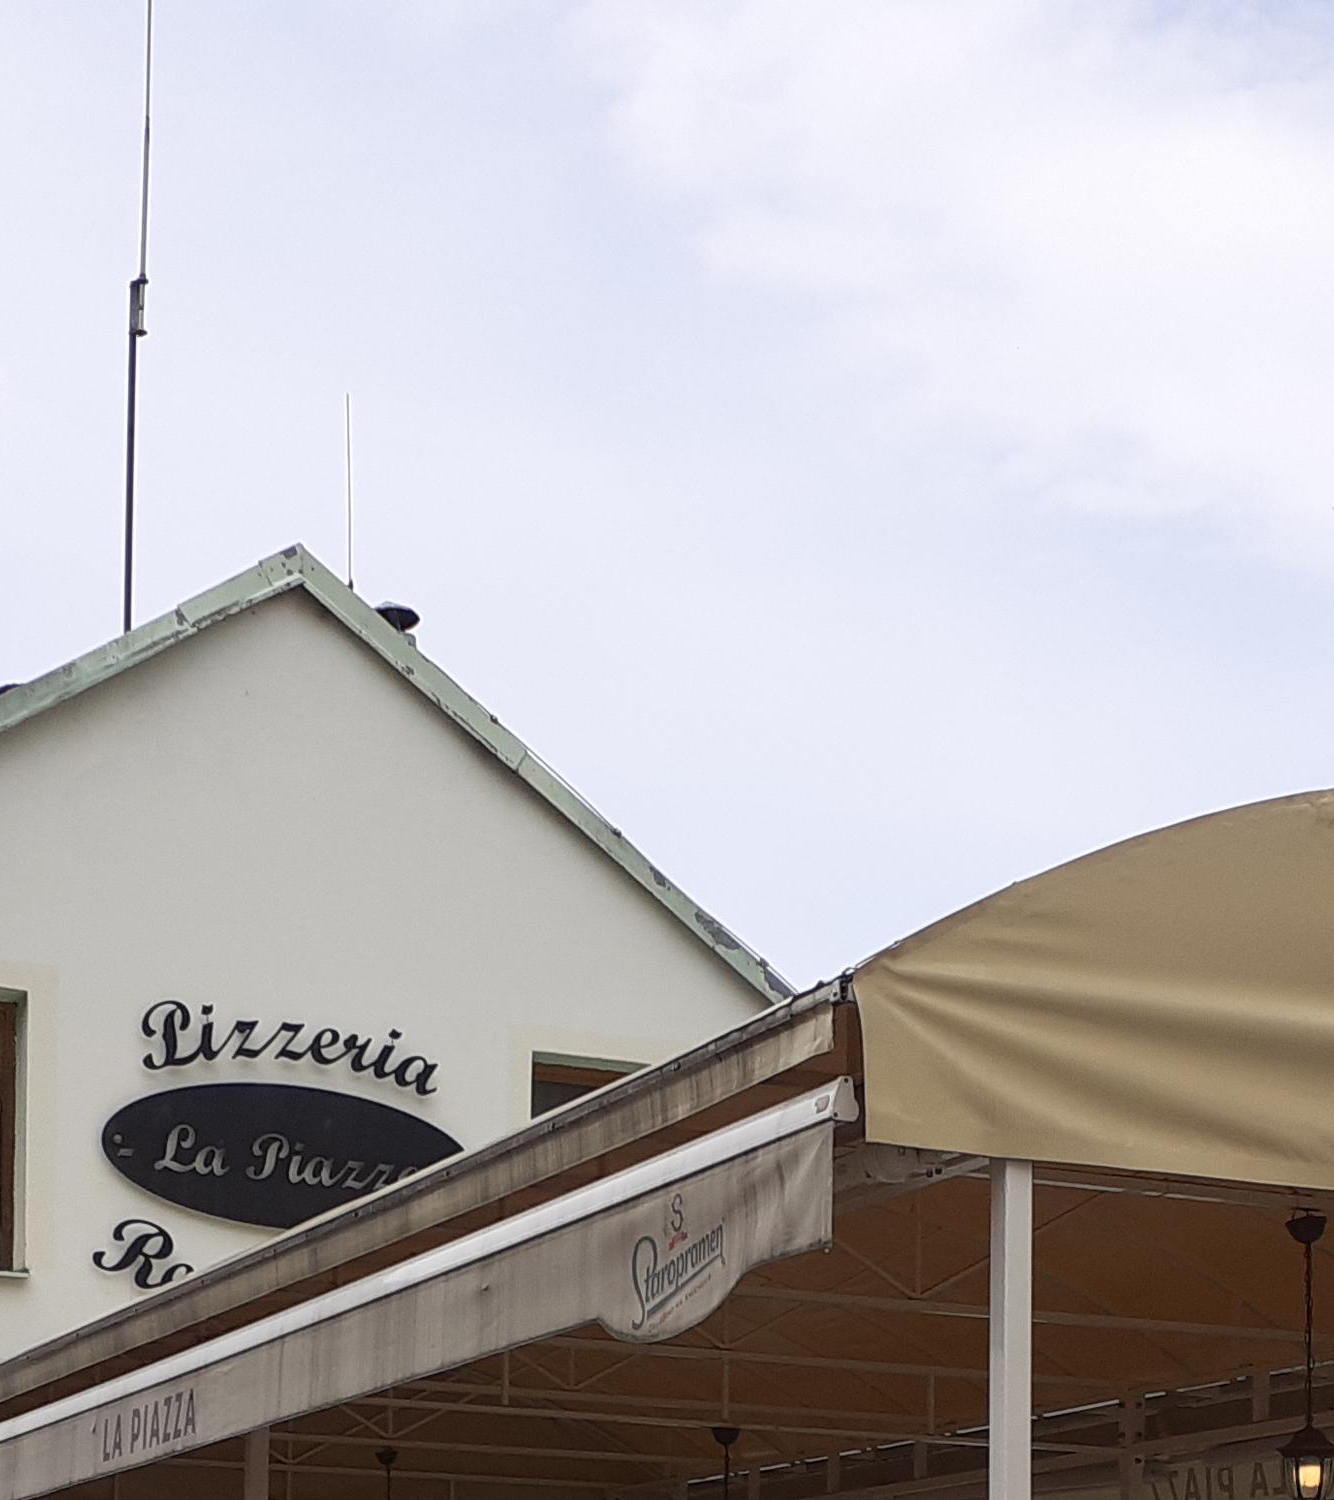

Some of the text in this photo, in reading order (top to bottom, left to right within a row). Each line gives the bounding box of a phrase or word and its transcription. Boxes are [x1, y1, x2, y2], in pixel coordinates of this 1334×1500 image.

[141, 999, 440, 1097] Pizzeria
[154, 1124, 230, 1177] La
[631, 1223, 726, 1331] Staropramen
[102, 1388, 196, 1462] LA PIAZZA
